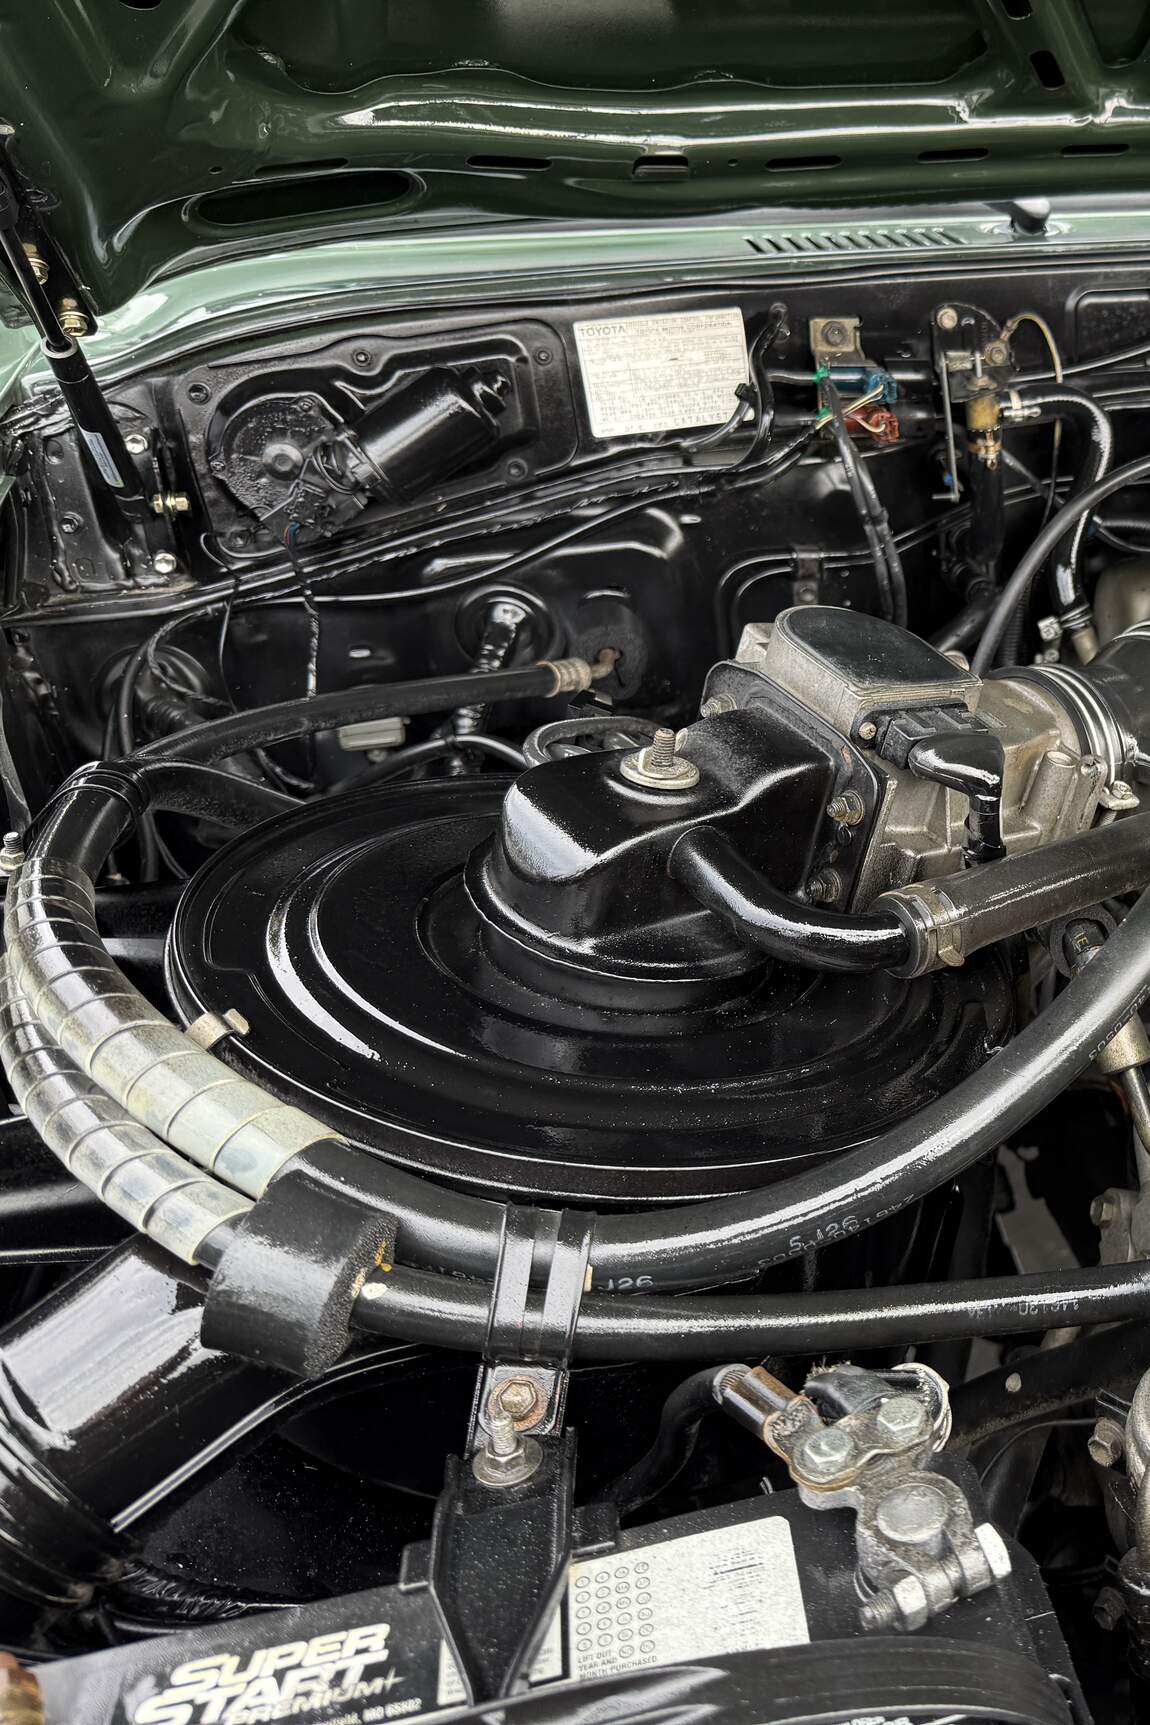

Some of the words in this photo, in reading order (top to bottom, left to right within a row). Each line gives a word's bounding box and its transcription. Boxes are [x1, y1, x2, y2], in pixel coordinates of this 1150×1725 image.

[579, 325, 626, 337] TOYOTA
[673, 411, 728, 425] CATALYST
[170, 1623, 391, 1688] SUPER
[596, 1649, 612, 1660] OUT
[578, 1660, 599, 1672] YEAR
[601, 1657, 618, 1666] AND
[610, 1655, 658, 1673] PURCHASED
[133, 1649, 389, 1725] START
